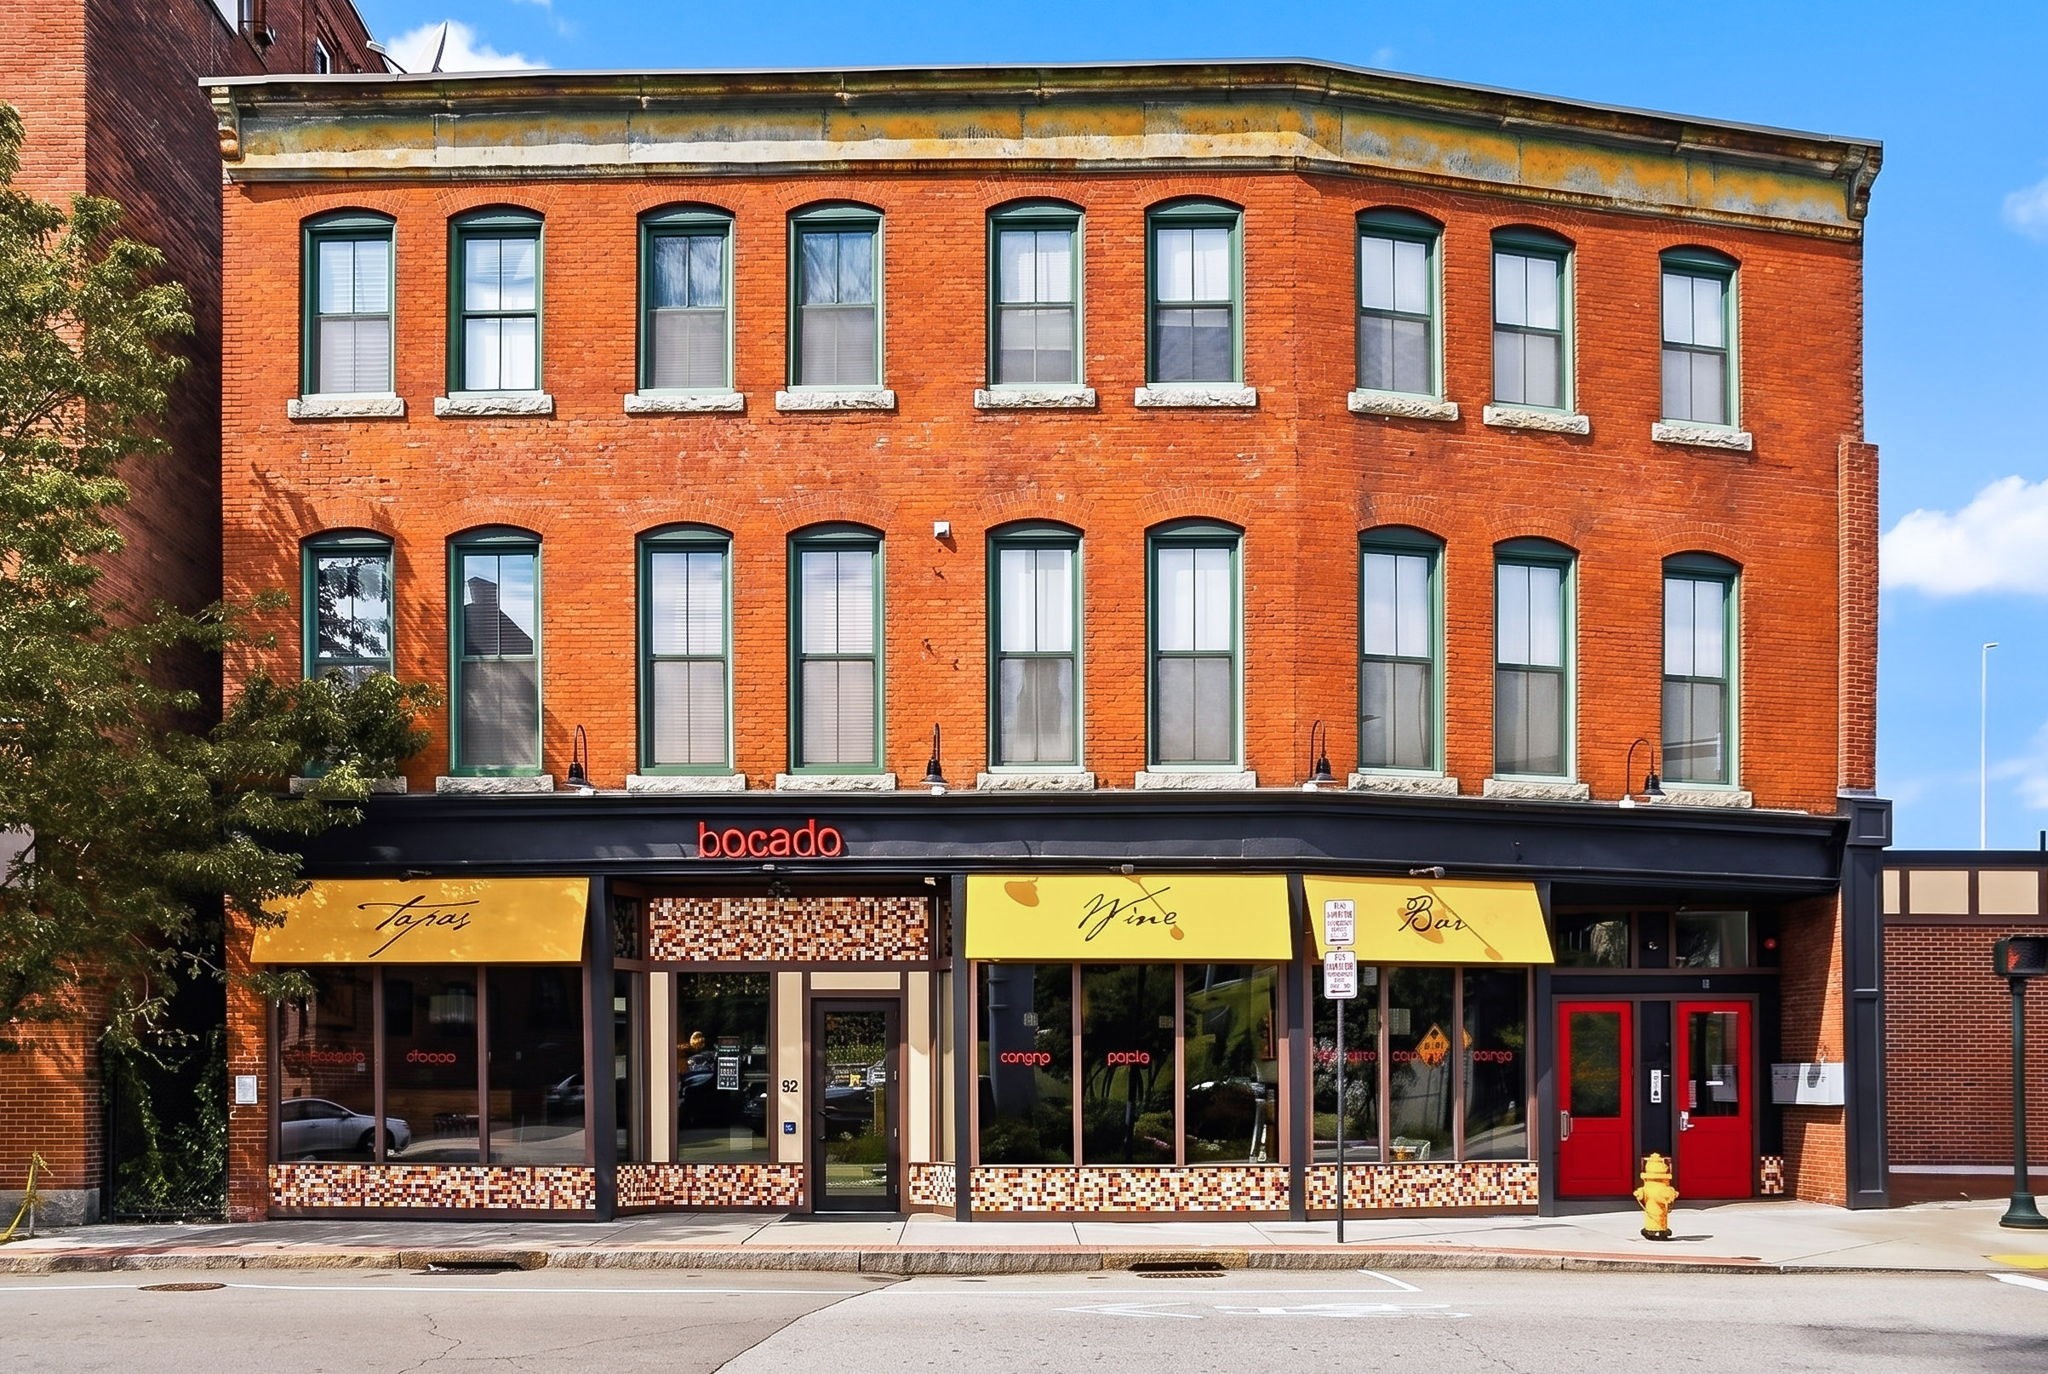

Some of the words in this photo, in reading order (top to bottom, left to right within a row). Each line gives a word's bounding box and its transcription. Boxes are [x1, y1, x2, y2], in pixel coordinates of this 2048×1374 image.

[698, 818, 843, 858] bocado
[357, 895, 480, 958] Tapas
[1078, 886, 1177, 942] Wine
[1398, 895, 1468, 932] Bar
[781, 1079, 799, 1093] 92
